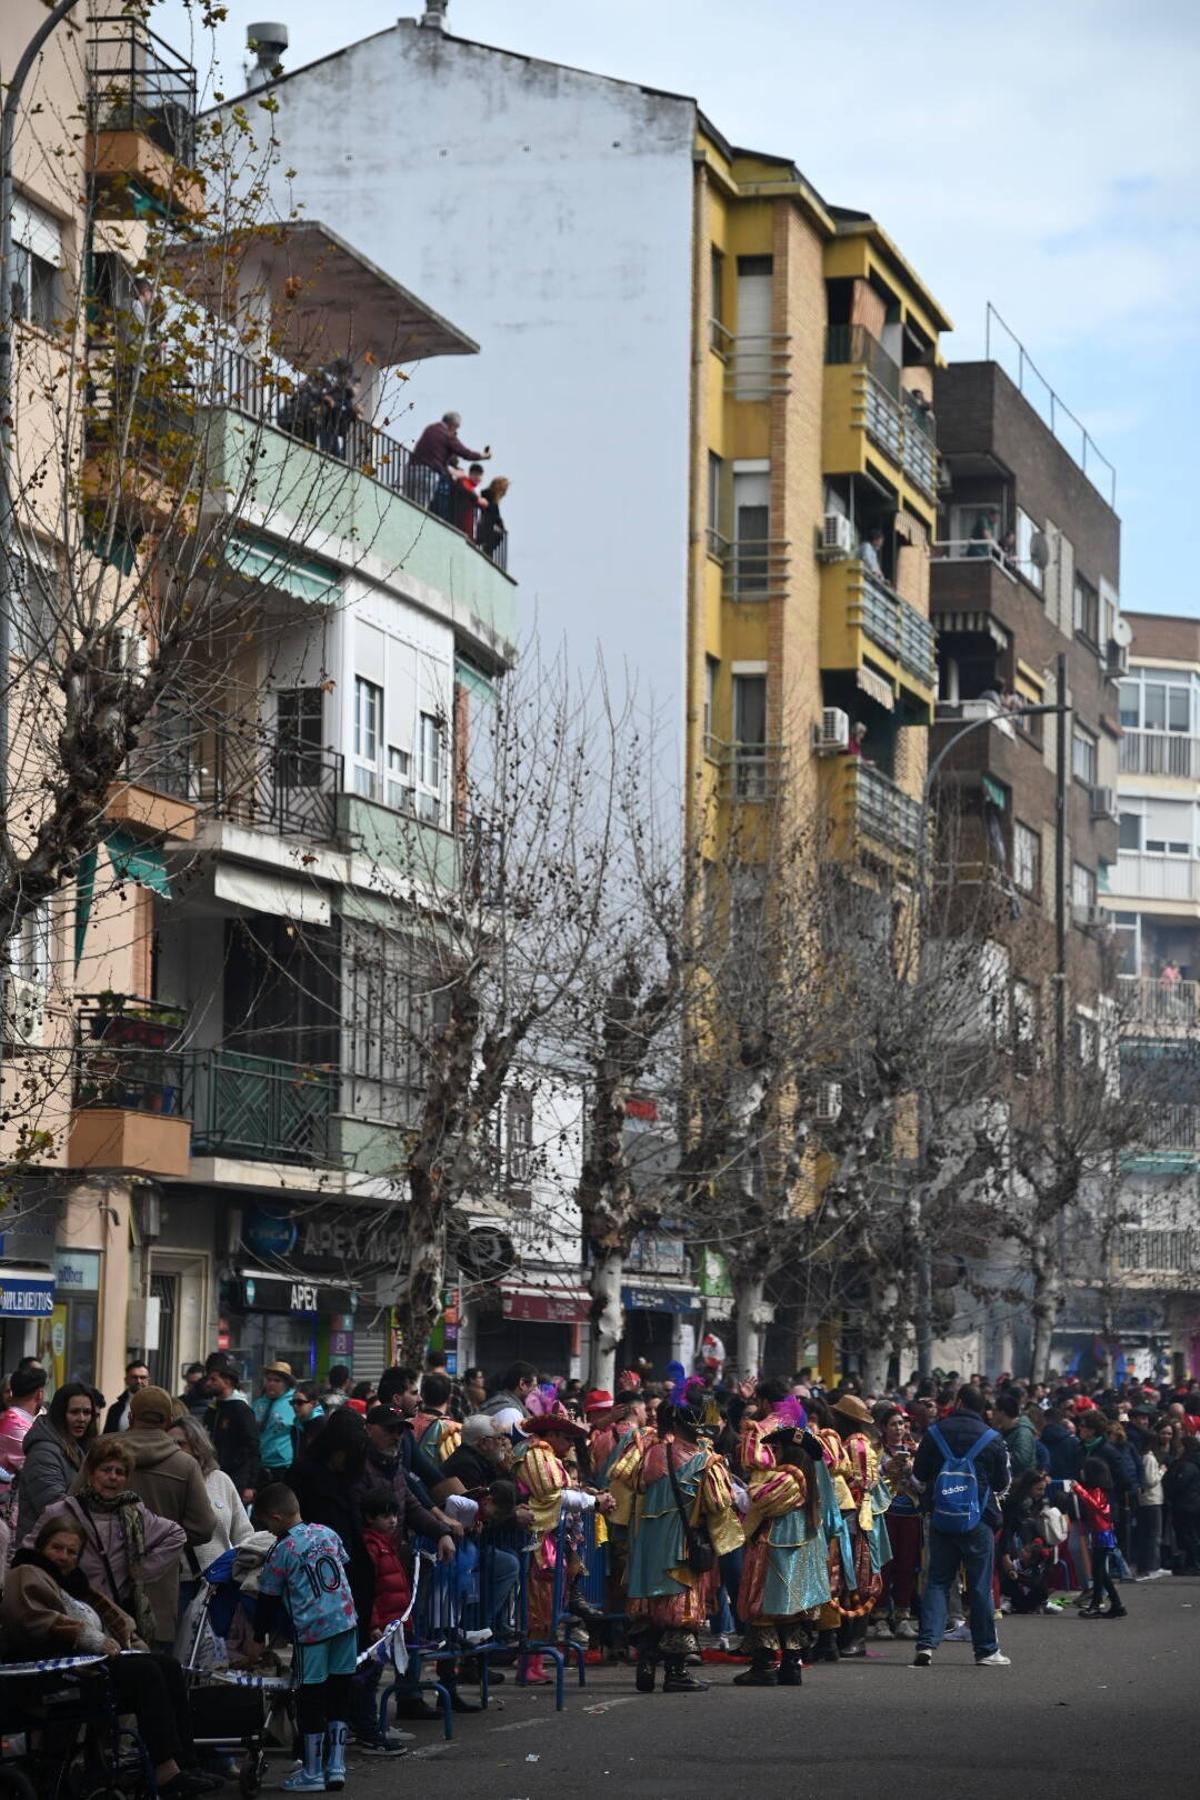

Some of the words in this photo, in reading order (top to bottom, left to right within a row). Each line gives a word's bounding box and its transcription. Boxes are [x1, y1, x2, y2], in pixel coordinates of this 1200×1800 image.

[303, 1222, 361, 1260] APEX
[291, 1284, 318, 1311] APEX
[300, 1555, 341, 1599] 10
